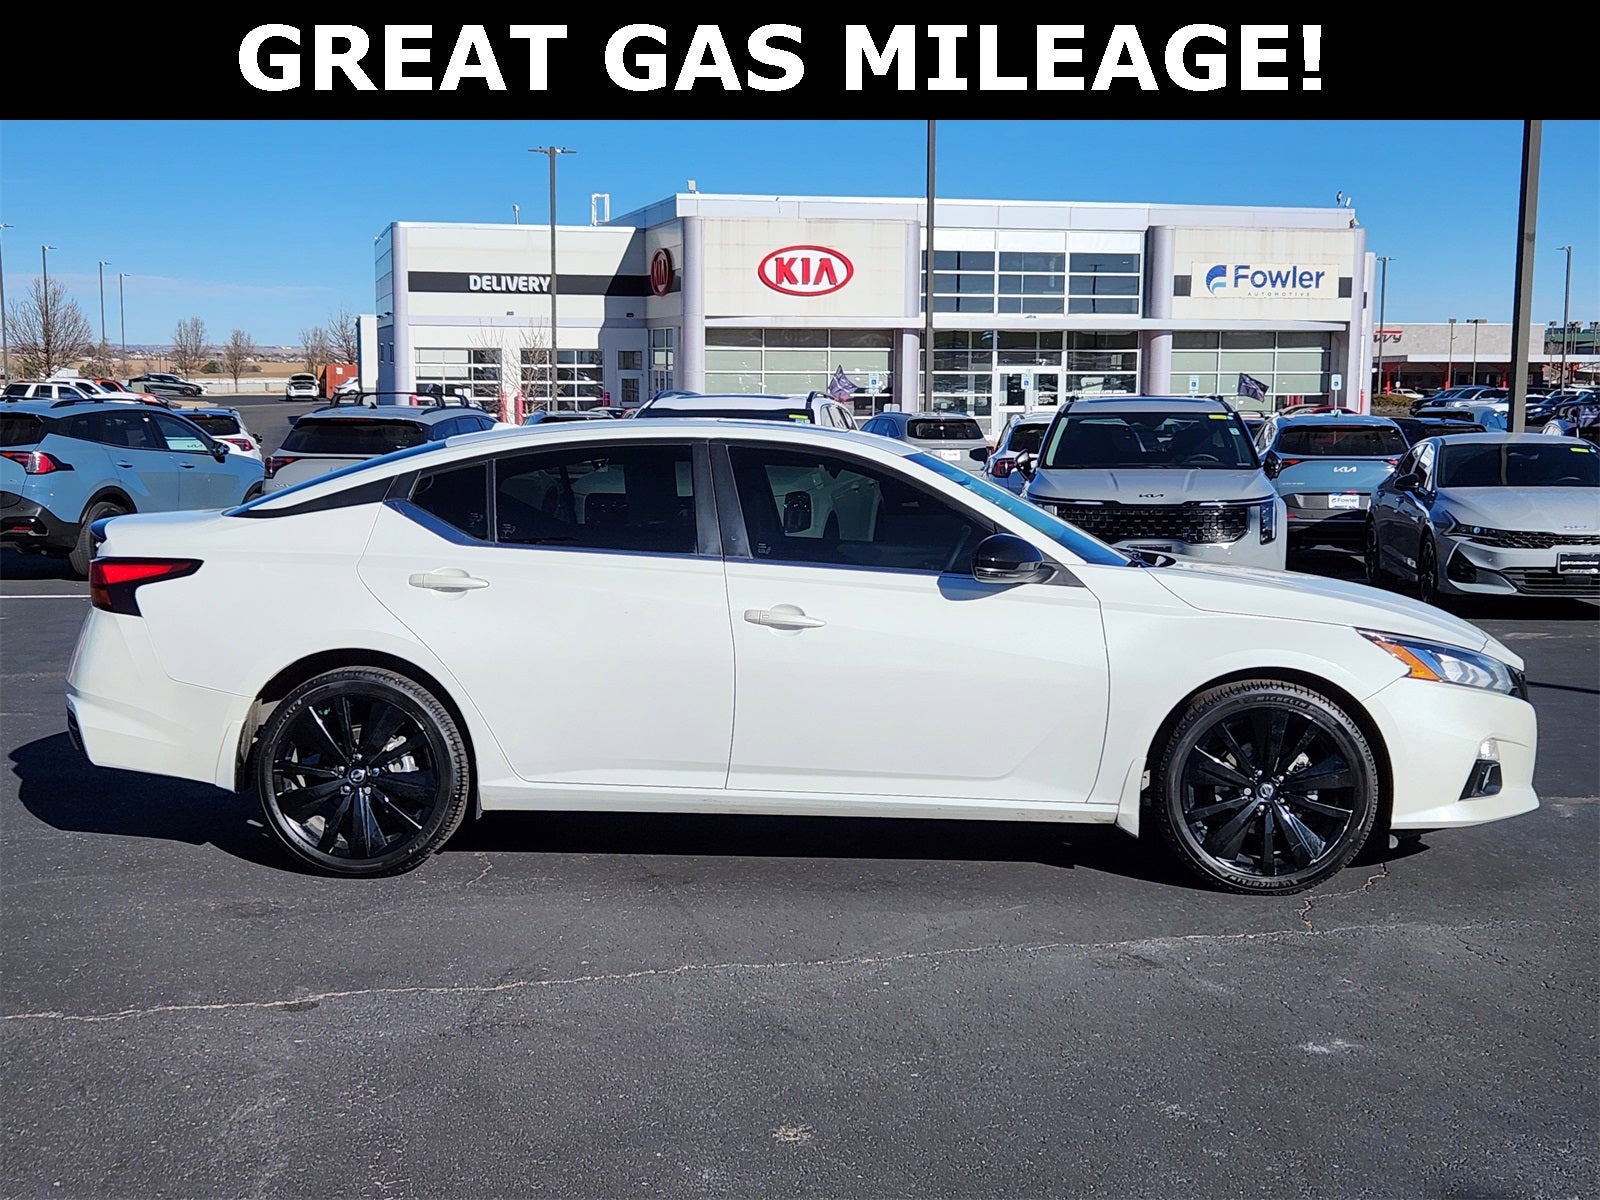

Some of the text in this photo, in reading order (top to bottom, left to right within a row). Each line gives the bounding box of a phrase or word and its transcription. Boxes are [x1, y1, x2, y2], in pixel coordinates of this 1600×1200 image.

[775, 257, 838, 286] KIA
[1233, 264, 1325, 289] Fowler
[469, 274, 551, 292] DELIVERY
[1256, 695, 1309, 708] MICHELIN
